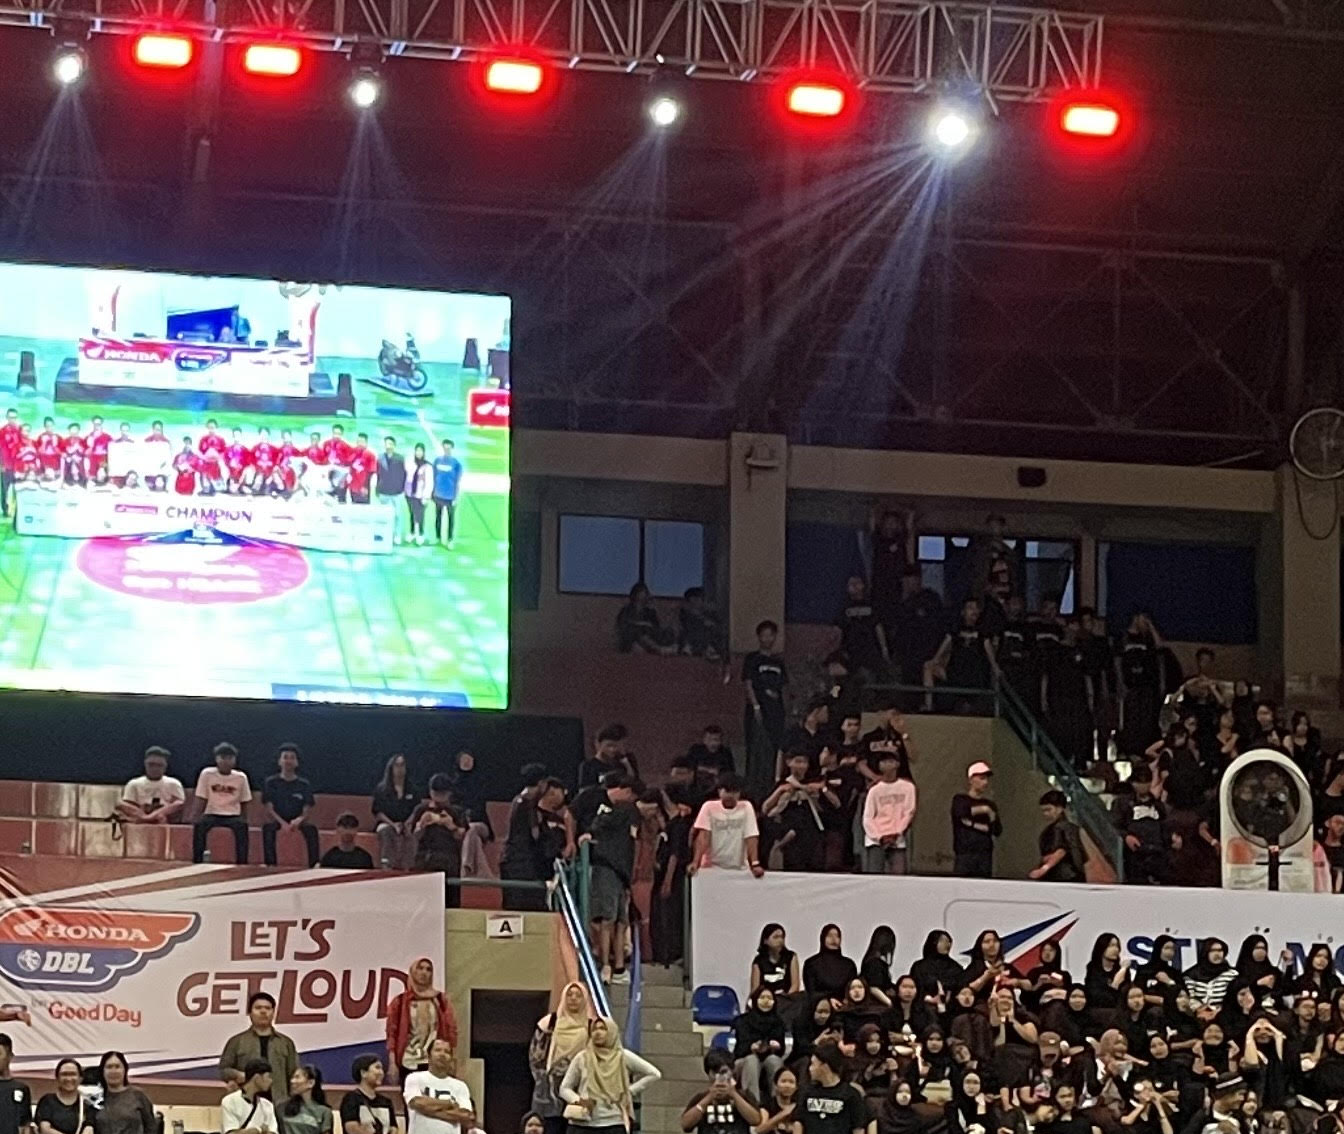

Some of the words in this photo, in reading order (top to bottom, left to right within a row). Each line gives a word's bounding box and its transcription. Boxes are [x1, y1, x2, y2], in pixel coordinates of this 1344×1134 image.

[45, 922, 149, 942] HONDA
[499, 920, 512, 933] A
[231, 918, 336, 961] LET'S
[42, 951, 95, 975] DBL
